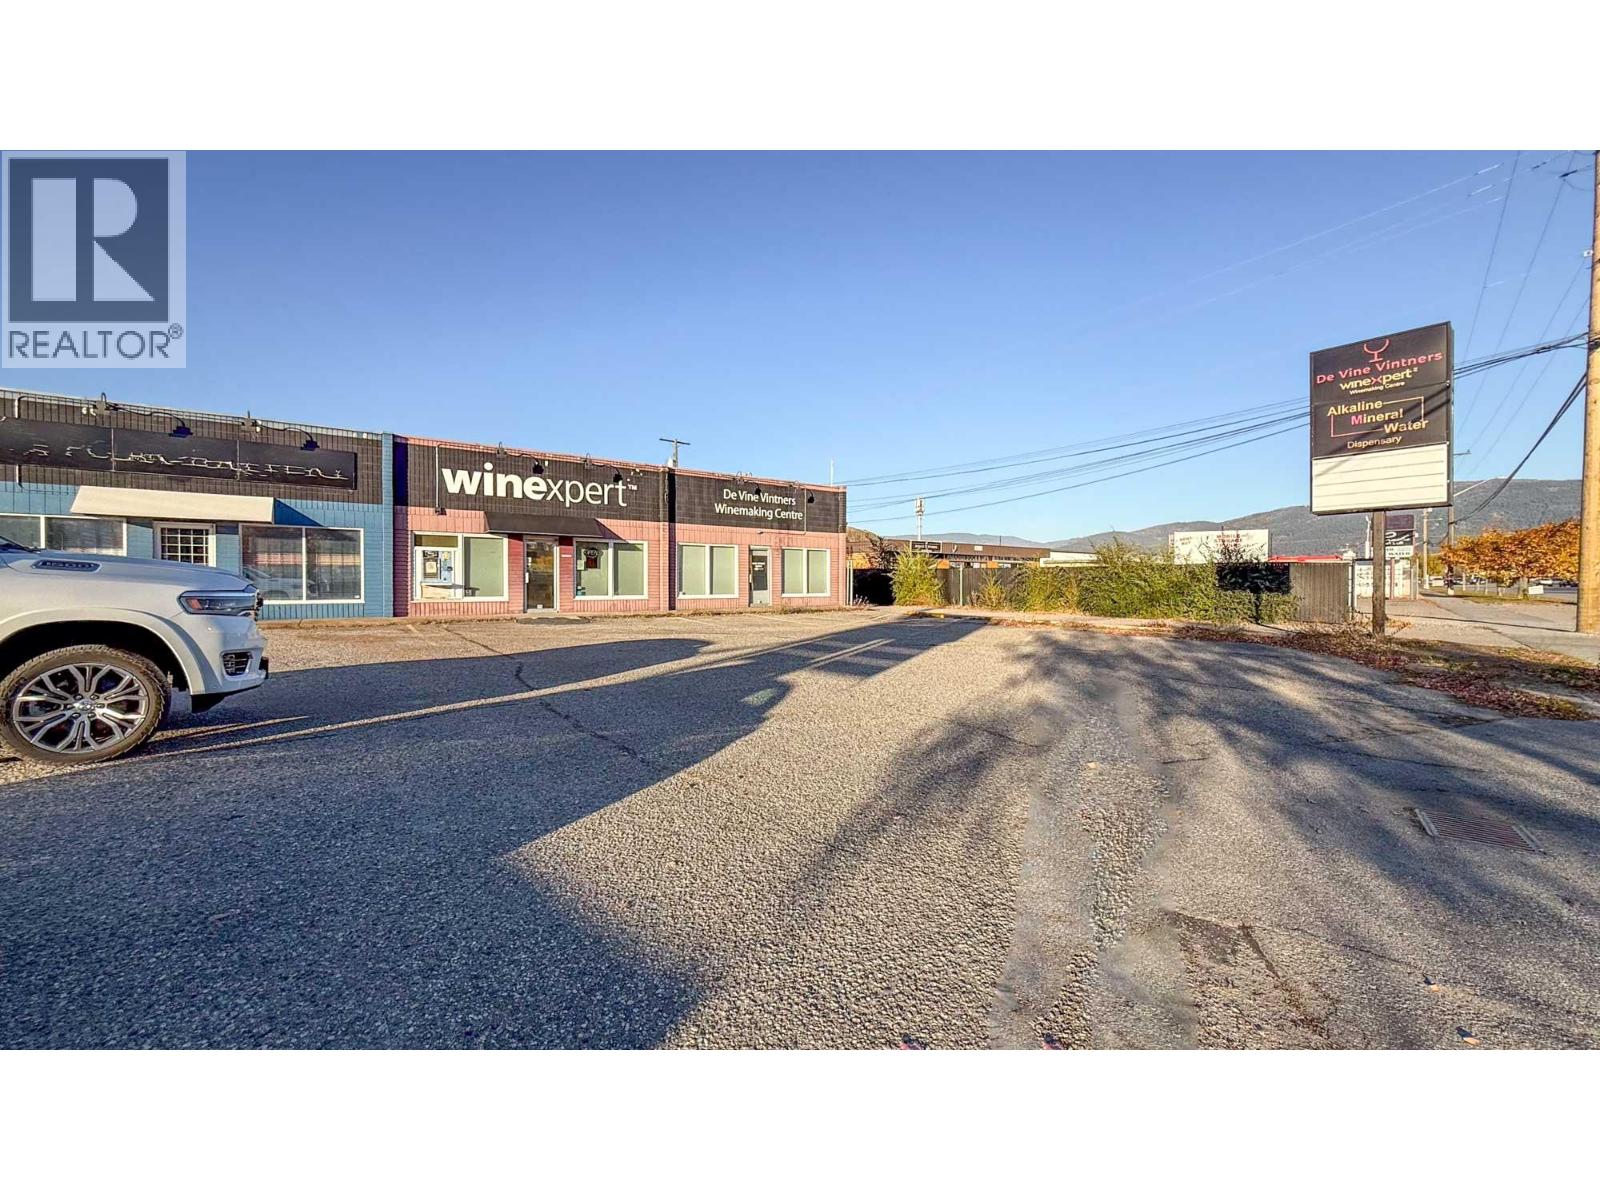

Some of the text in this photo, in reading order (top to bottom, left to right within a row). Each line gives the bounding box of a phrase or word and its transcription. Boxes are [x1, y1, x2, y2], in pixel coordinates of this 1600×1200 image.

[1316, 351, 1443, 384] De Vine Vintners
[1349, 384, 1384, 396] Winemaking
[1327, 400, 1383, 416] Alkaline
[1350, 408, 1404, 426] Mineral
[1383, 419, 1429, 434] Water
[1347, 435, 1402, 449] Dispensary
[723, 488, 796, 505] De Vine Vintners
[714, 502, 804, 520] Winemaking Centre
